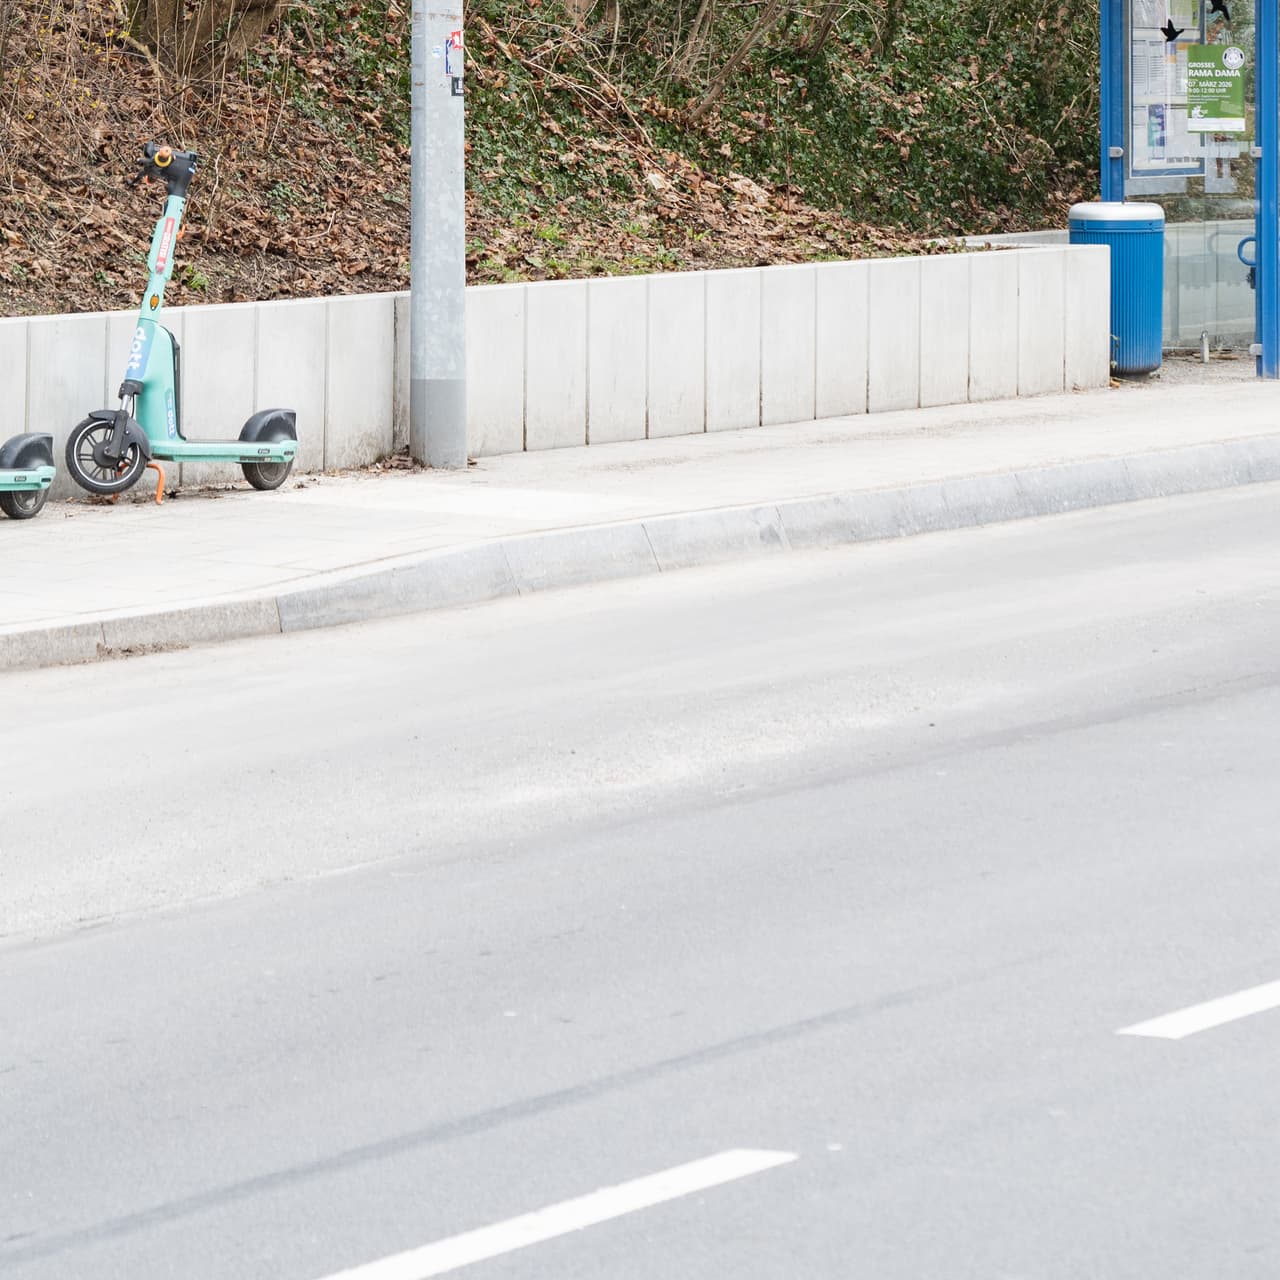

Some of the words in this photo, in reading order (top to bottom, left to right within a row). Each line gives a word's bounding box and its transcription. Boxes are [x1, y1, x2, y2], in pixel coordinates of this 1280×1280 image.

[1188, 69, 1214, 77] RAMA
[1215, 69, 1241, 77] DAMA
[127, 326, 147, 370] dott
[167, 409, 176, 435] dott
